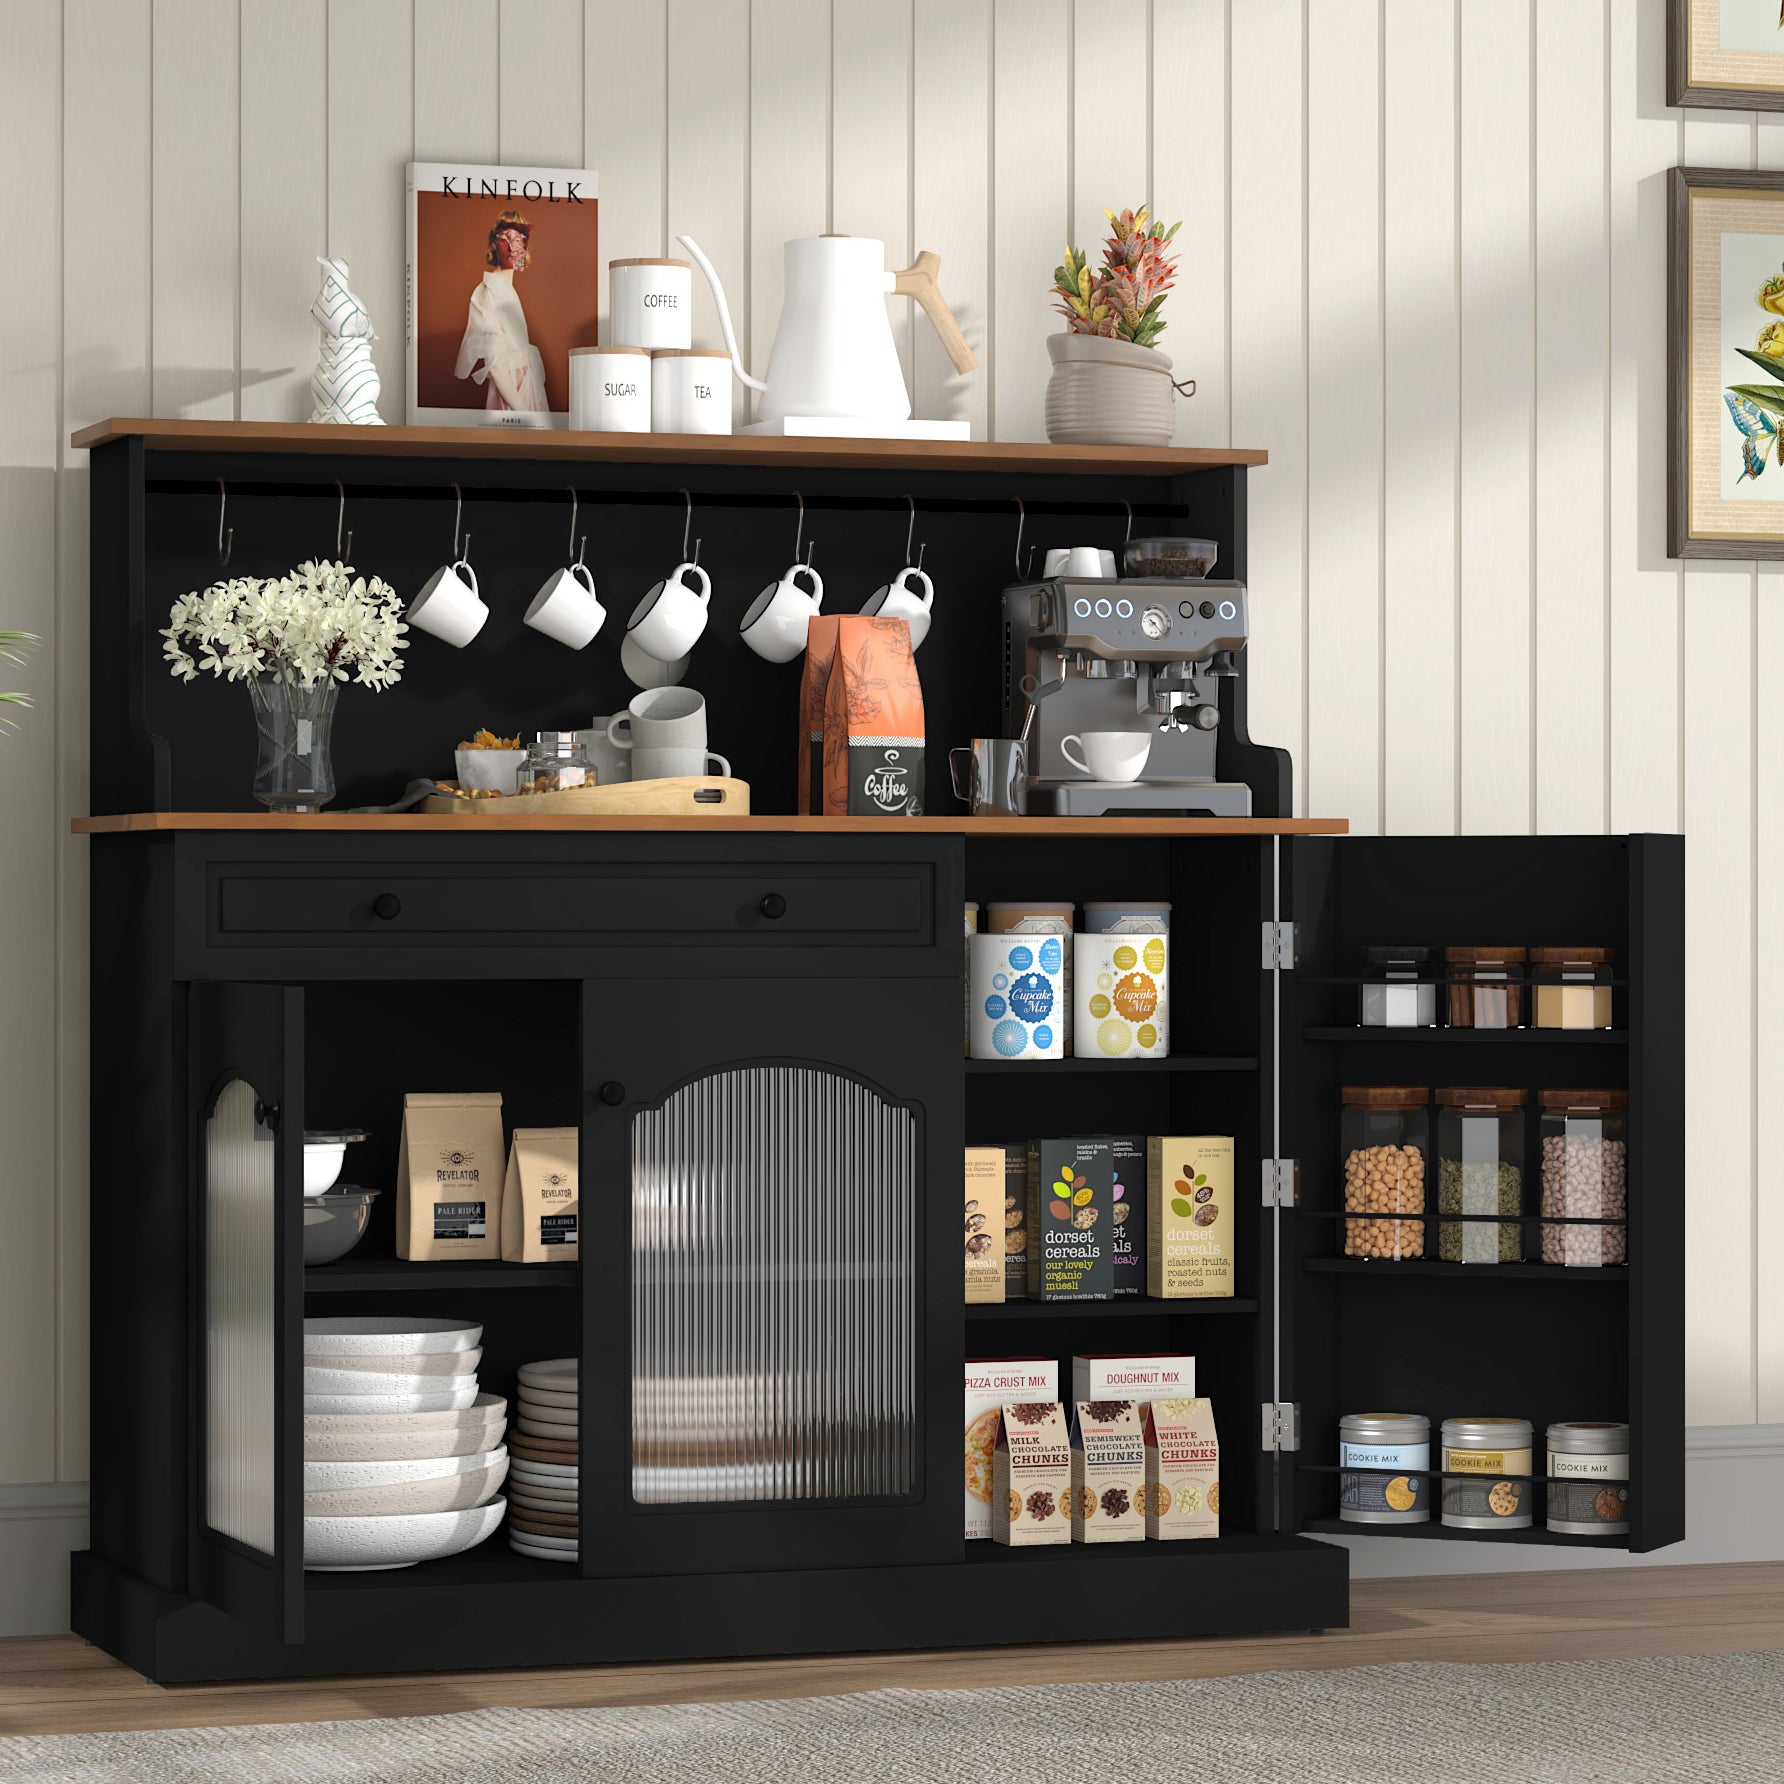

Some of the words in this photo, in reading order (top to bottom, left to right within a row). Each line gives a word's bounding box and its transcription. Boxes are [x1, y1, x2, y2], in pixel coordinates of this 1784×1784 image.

[442, 176, 584, 204] KINFOLK
[644, 294, 678, 309] COFFEE
[604, 383, 637, 398] SUGAR
[694, 385, 712, 399] TEA
[864, 774, 909, 802] Coffee
[1011, 987, 1052, 1004] Cupcake
[1116, 987, 1156, 1003] Cupcake
[1024, 1000, 1049, 1014] Mix
[1128, 1000, 1152, 1013] Mix
[437, 1169, 480, 1182] REVELATOR
[541, 1188, 572, 1199] REVELATOR
[437, 1207, 456, 1215] PALE
[458, 1207, 481, 1215] RIDER
[1045, 1230, 1095, 1243] dorset
[1167, 1228, 1215, 1241] dorset
[1045, 1245, 1100, 1258] cereals
[1166, 1242, 1221, 1256] cereals
[1045, 1261, 1064, 1270] our
[1065, 1260, 1094, 1271] lovely
[1167, 1258, 1200, 1266] classic
[1045, 1270, 1083, 1281] organic
[1167, 1268, 1203, 1277] roasted
[1205, 1268, 1227, 1276] nuts
[1045, 1281, 1079, 1291] muesli
[1167, 1279, 1176, 1287] &
[1177, 1278, 1204, 1287] seeds
[964, 1377, 991, 1388] PIZZA
[993, 1376, 1026, 1388] CRUST
[1028, 1376, 1046, 1387] MIX
[1106, 1372, 1159, 1384] DOUGHNUT
[1162, 1372, 1180, 1383] MIX
[1010, 1437, 1040, 1445] MILK
[1085, 1434, 1141, 1443] SEMISWEET
[1159, 1431, 1198, 1440] WHITE
[1011, 1445, 1068, 1453] CHOCOLATE
[1160, 1440, 1217, 1448] CHOCOLATE
[1012, 1454, 1069, 1464] CHUNKS
[1087, 1451, 1143, 1461] CHUNKS
[1161, 1448, 1217, 1459] CHUNKS
[1348, 1453, 1379, 1462] COOKIE
[1381, 1455, 1399, 1463] MIX
[1450, 1458, 1481, 1467] COOKIE
[1484, 1460, 1502, 1468] MIX
[1556, 1463, 1588, 1472] COOKIE
[1591, 1465, 1608, 1473] MIX
